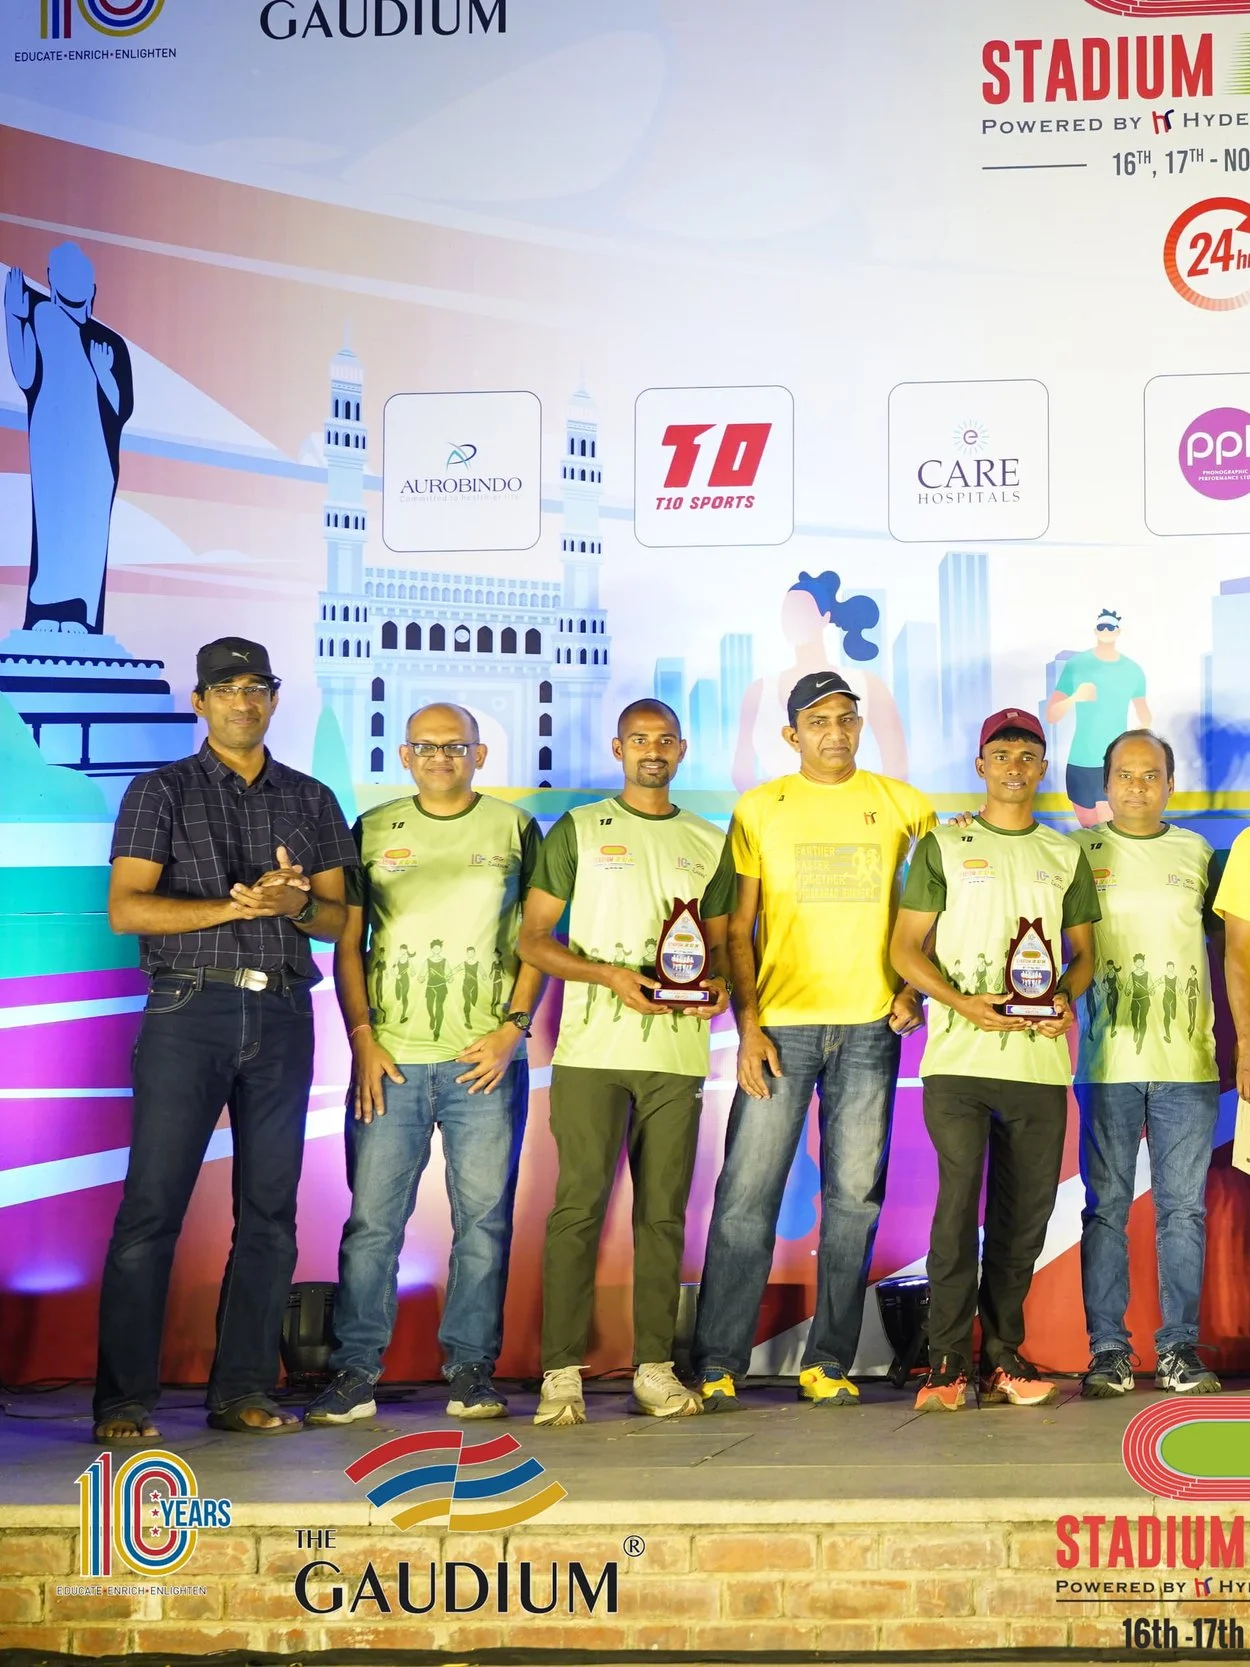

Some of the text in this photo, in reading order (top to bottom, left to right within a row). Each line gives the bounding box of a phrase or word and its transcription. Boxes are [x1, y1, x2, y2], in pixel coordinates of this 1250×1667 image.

[260, 0, 507, 40] GAUDIUM
[982, 33, 1213, 104] STADIUM
[400, 477, 522, 493] AUROBINDO
[918, 459, 1020, 489] CARE
[656, 496, 755, 510] T10 SPORTS
[918, 491, 1020, 504] HOSPITALS
